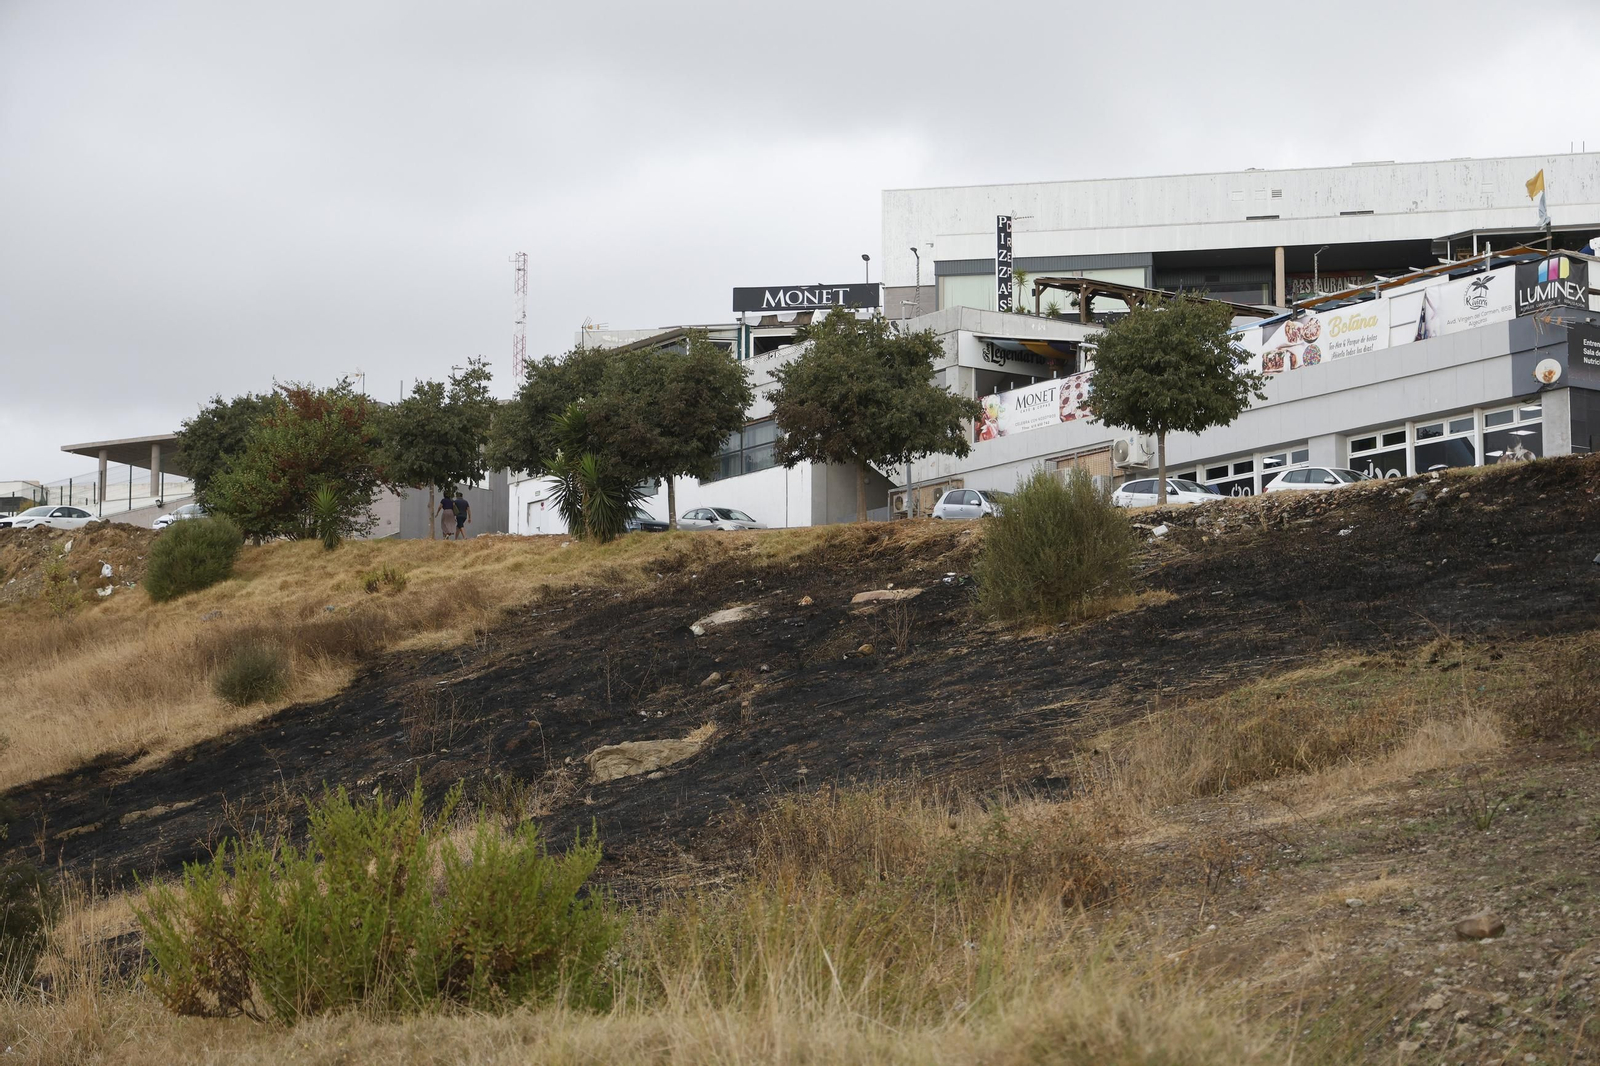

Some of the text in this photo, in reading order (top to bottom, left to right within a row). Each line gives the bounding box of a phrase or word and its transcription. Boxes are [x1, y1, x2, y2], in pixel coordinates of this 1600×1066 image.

[998, 216, 1008, 312] PIZZAS
[761, 287, 850, 309] MONET
[1519, 281, 1586, 306] LUMINEX
[1328, 312, 1379, 338] Botana
[991, 342, 1046, 367] Legendario
[1583, 347, 1595, 356] Sala
[1015, 386, 1057, 411] MONET
